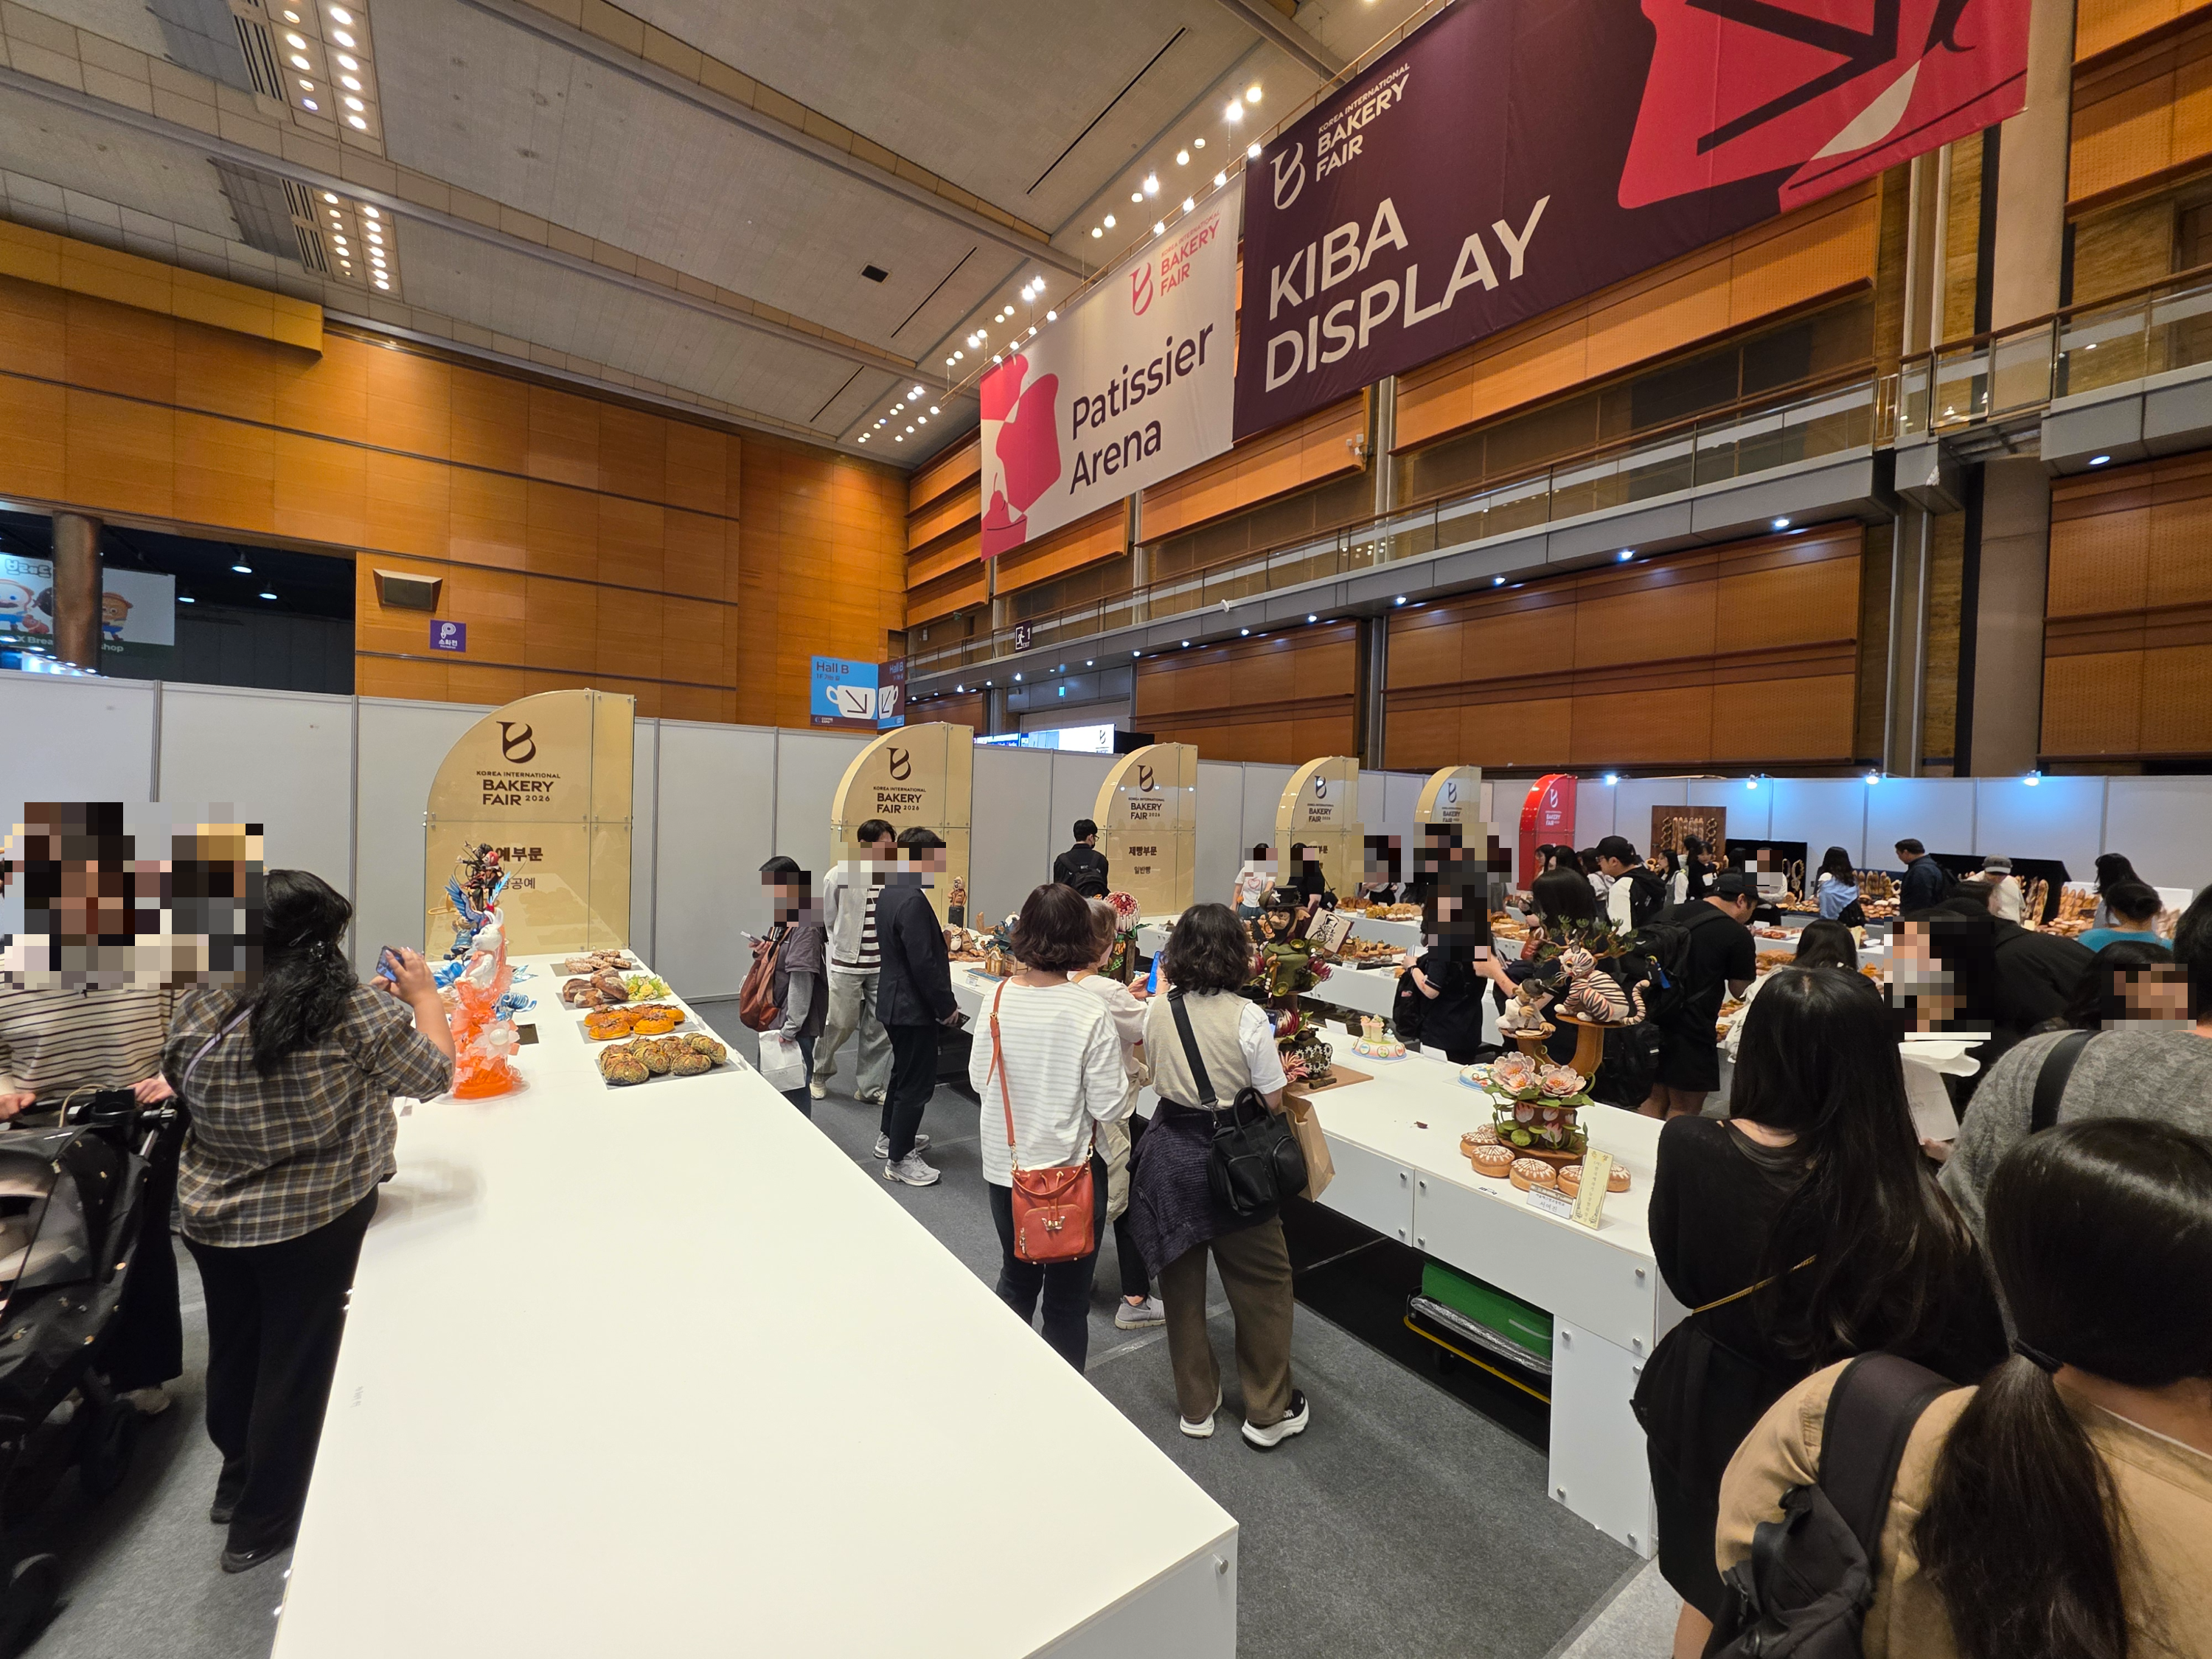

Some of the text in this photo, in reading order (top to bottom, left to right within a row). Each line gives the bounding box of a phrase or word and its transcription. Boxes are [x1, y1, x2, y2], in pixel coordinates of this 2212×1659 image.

[1318, 63, 1410, 134] KOREA INTERNATIONAL
[1318, 73, 1409, 157] BAKERY
[1316, 134, 1363, 182] FAIR
[1161, 219, 1220, 276] BAKERY
[1269, 197, 1408, 321] KIBA
[1161, 262, 1190, 296] FAIR
[1266, 195, 1551, 393] DISPLAY
[1073, 323, 1214, 441] Patissier
[1069, 420, 1161, 495] Arena
[1027, 627, 1031, 640] 1
[27, 636, 53, 645] Brea
[816, 661, 849, 674] Hall B
[889, 661, 904, 675] Hall B
[483, 779, 554, 792] BAKERY
[483, 793, 521, 805] FAIR
[877, 793, 922, 803] BAKERY
[877, 804, 901, 814] FAIR
[1130, 802, 1162, 810] BAKERY
[1130, 812, 1147, 820] FAIR
[495, 847, 543, 862] 예부문
[1128, 846, 1158, 856] 제빵부문
[1134, 866, 1151, 874] 일반빵
